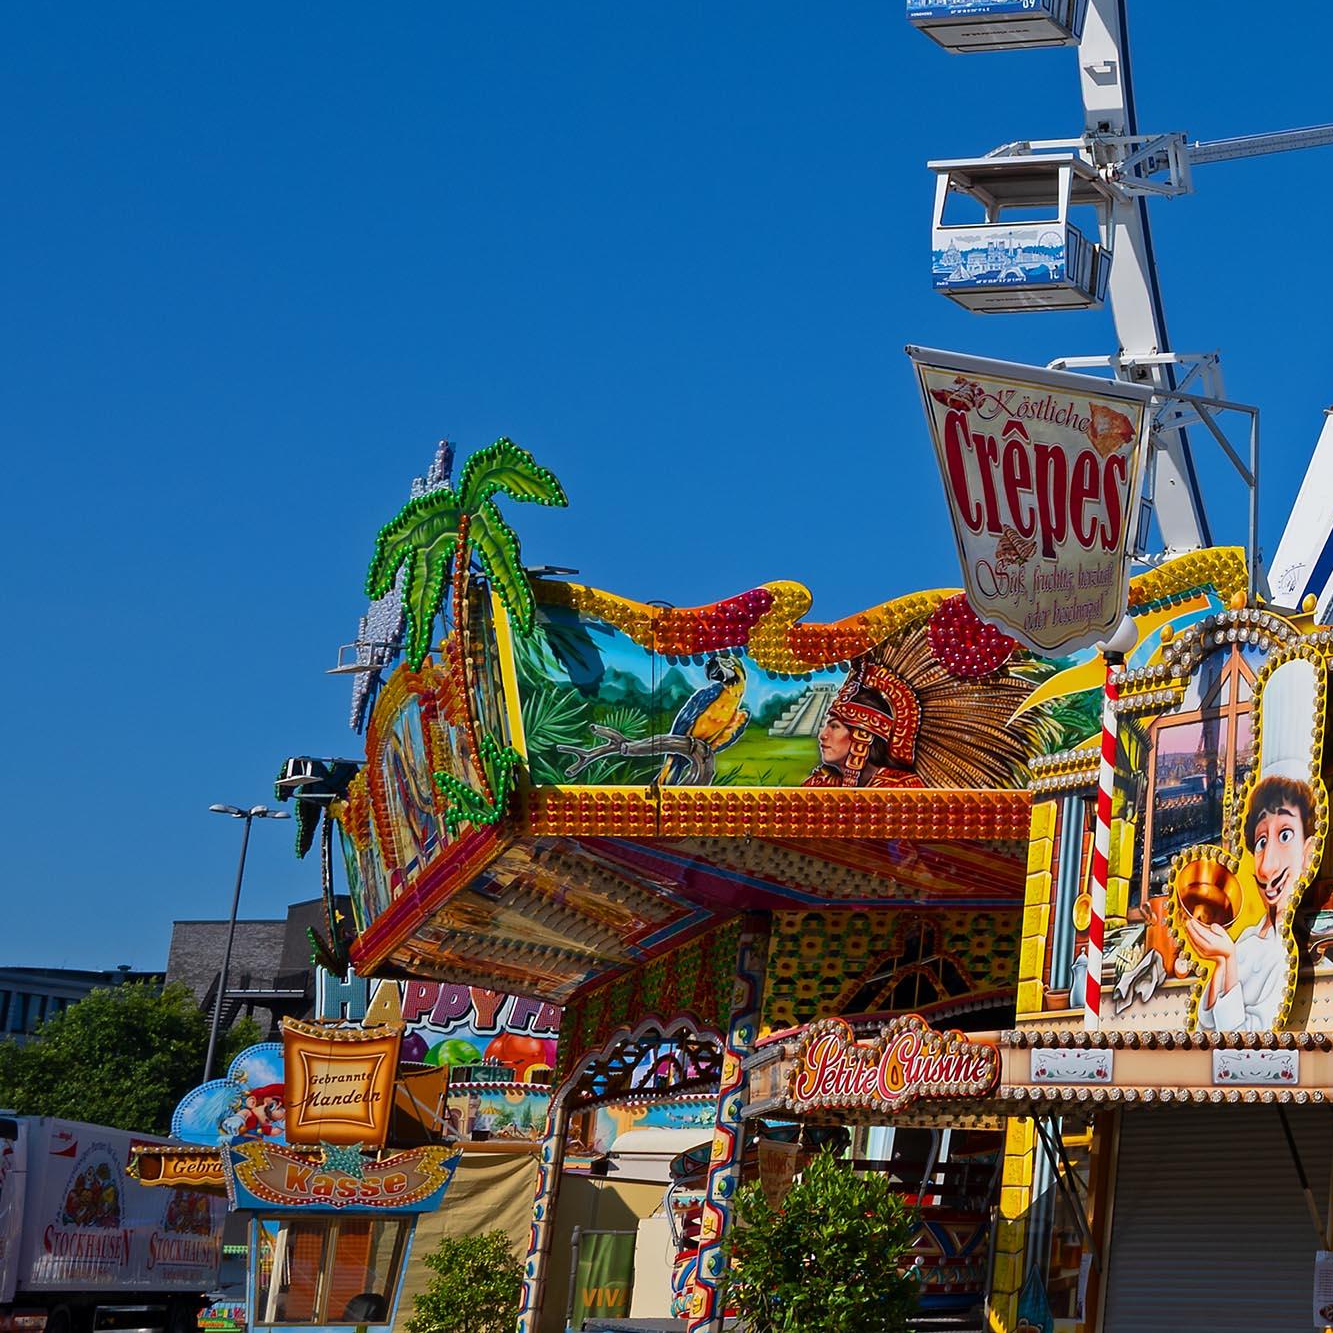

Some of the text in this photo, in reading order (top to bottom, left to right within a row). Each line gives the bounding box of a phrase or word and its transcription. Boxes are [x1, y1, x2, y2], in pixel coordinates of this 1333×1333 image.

[974, 388, 1090, 433] Köstliche
[944, 409, 1128, 562] Crêpes
[320, 967, 502, 1028] HAPPY
[309, 1072, 373, 1086] Gebrannte
[796, 1029, 987, 1102] Petite Cuisine
[291, 1088, 381, 1108] Mandeln
[173, 1159, 222, 1174] Gebra
[285, 1164, 408, 1200] Kasse
[44, 1225, 134, 1267] STOCKHAUSEN
